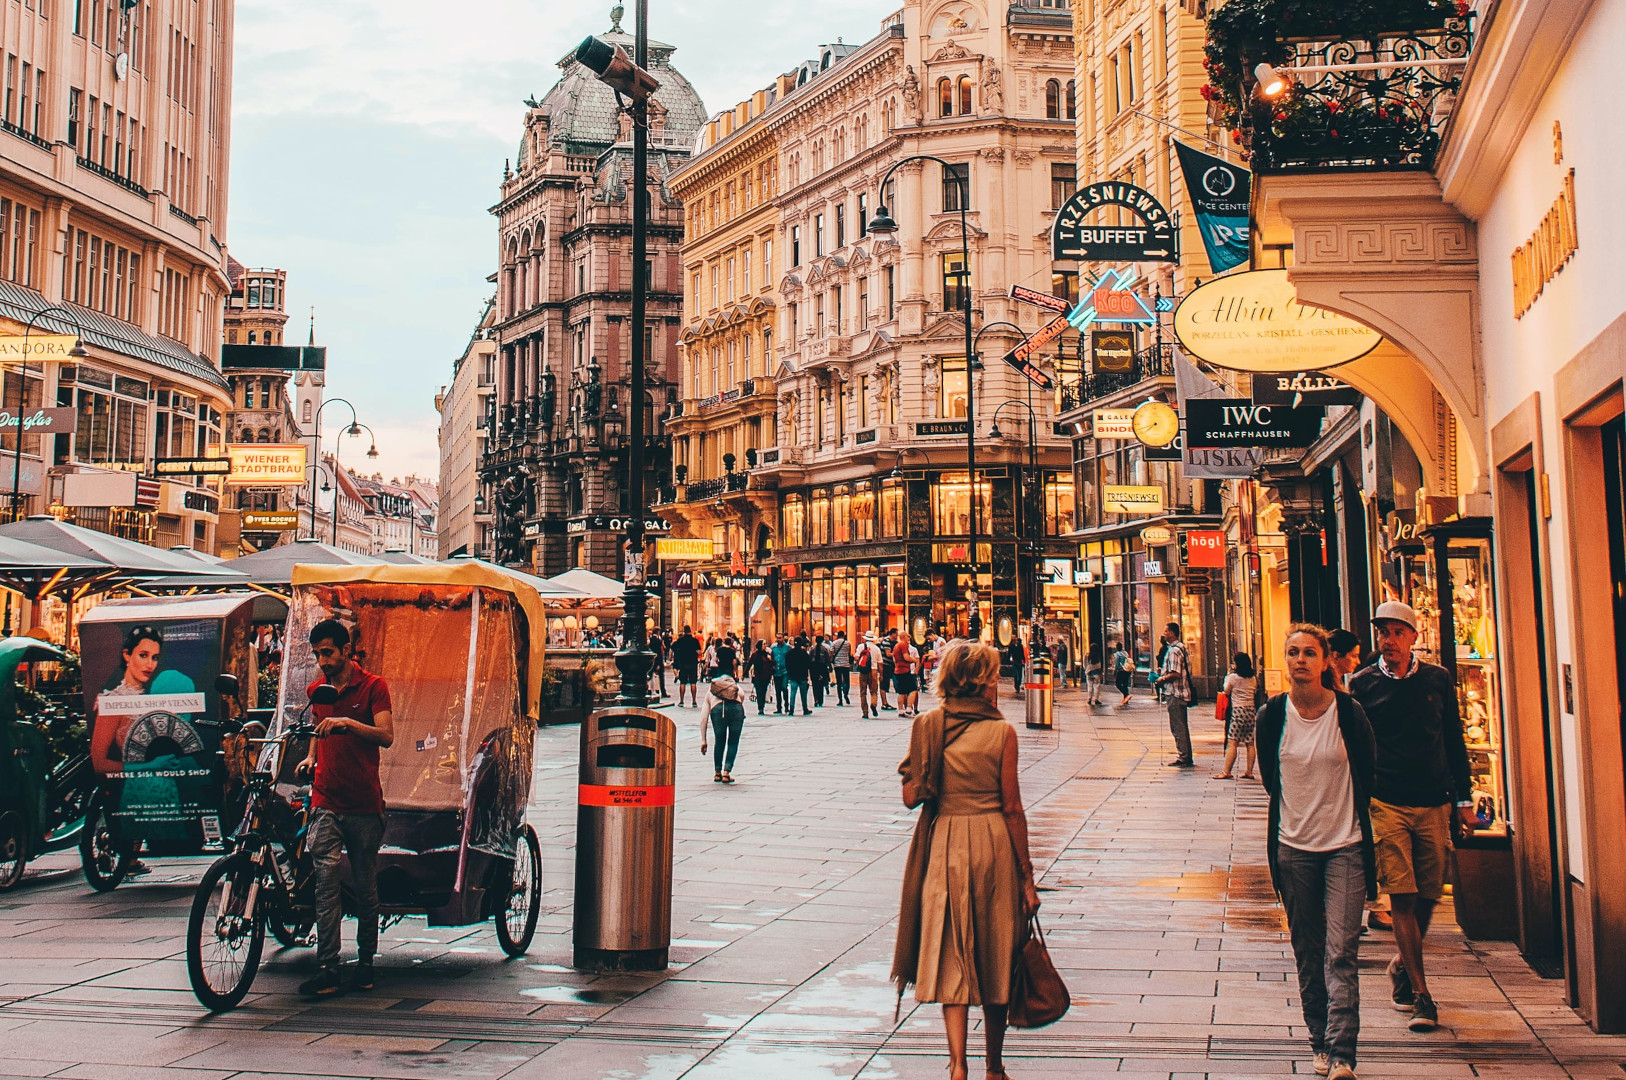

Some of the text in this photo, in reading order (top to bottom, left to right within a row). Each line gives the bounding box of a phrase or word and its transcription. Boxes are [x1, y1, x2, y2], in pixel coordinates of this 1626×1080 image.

[1080, 230, 1148, 244] BUFFET
[1191, 296, 1275, 325] Albin
[1192, 331, 1251, 341] PORZELLAN
[1257, 329, 1304, 338] KRISTALL
[1311, 327, 1372, 337] GESCHENKE
[1276, 377, 1338, 391] BALLY
[1222, 406, 1271, 426] IWC
[922, 425, 929, 433] E.
[930, 425, 952, 433] BRAUN
[1206, 430, 1291, 438] SCHAFFHAUSEN
[245, 455, 290, 463] WIENER
[1187, 449, 1257, 467] LISKA
[156, 462, 192, 473] GERRY
[104, 698, 200, 710] IMPERIAL SHOP VIENNA
[105, 769, 211, 779] WHERE SISI WOULD SHOP
